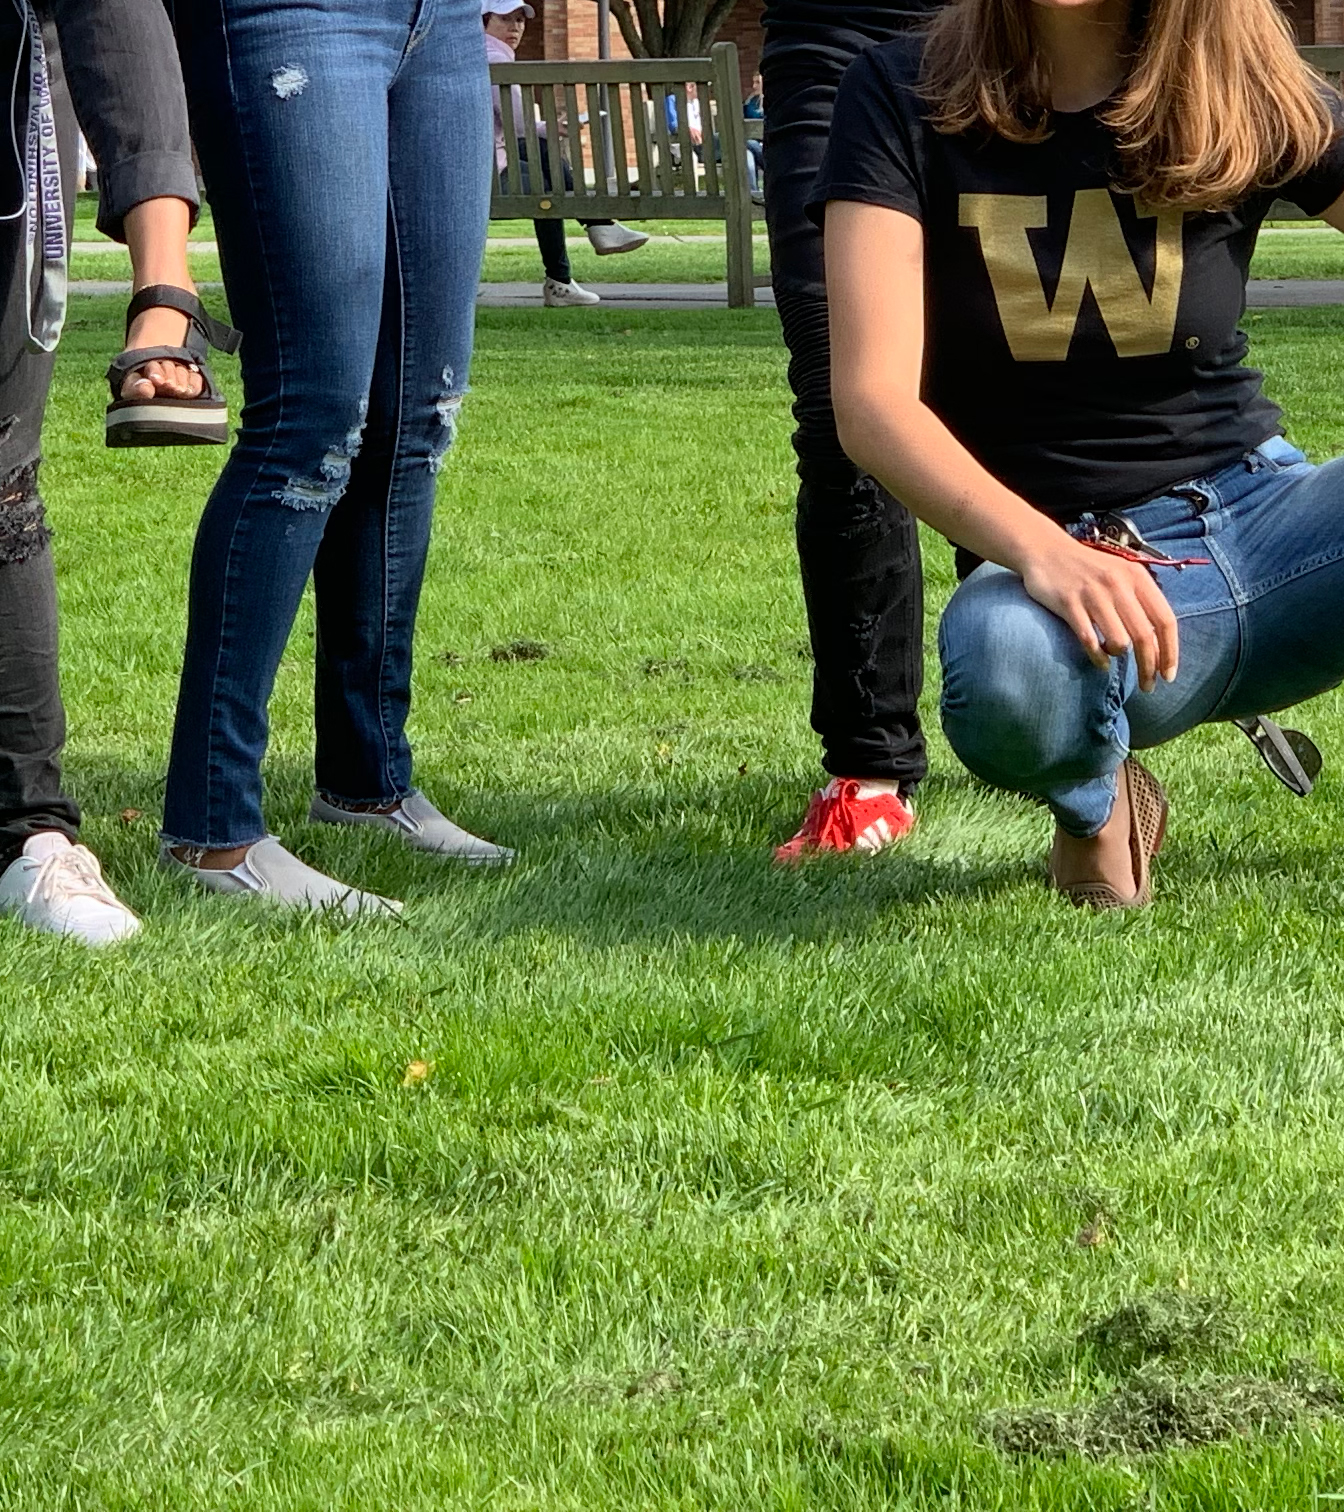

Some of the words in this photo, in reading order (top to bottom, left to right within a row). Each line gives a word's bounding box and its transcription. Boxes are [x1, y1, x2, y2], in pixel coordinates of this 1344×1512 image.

[41, 115, 54, 137] OF
[42, 145, 64, 260] UNIVERSITY
[958, 188, 1202, 362] W
